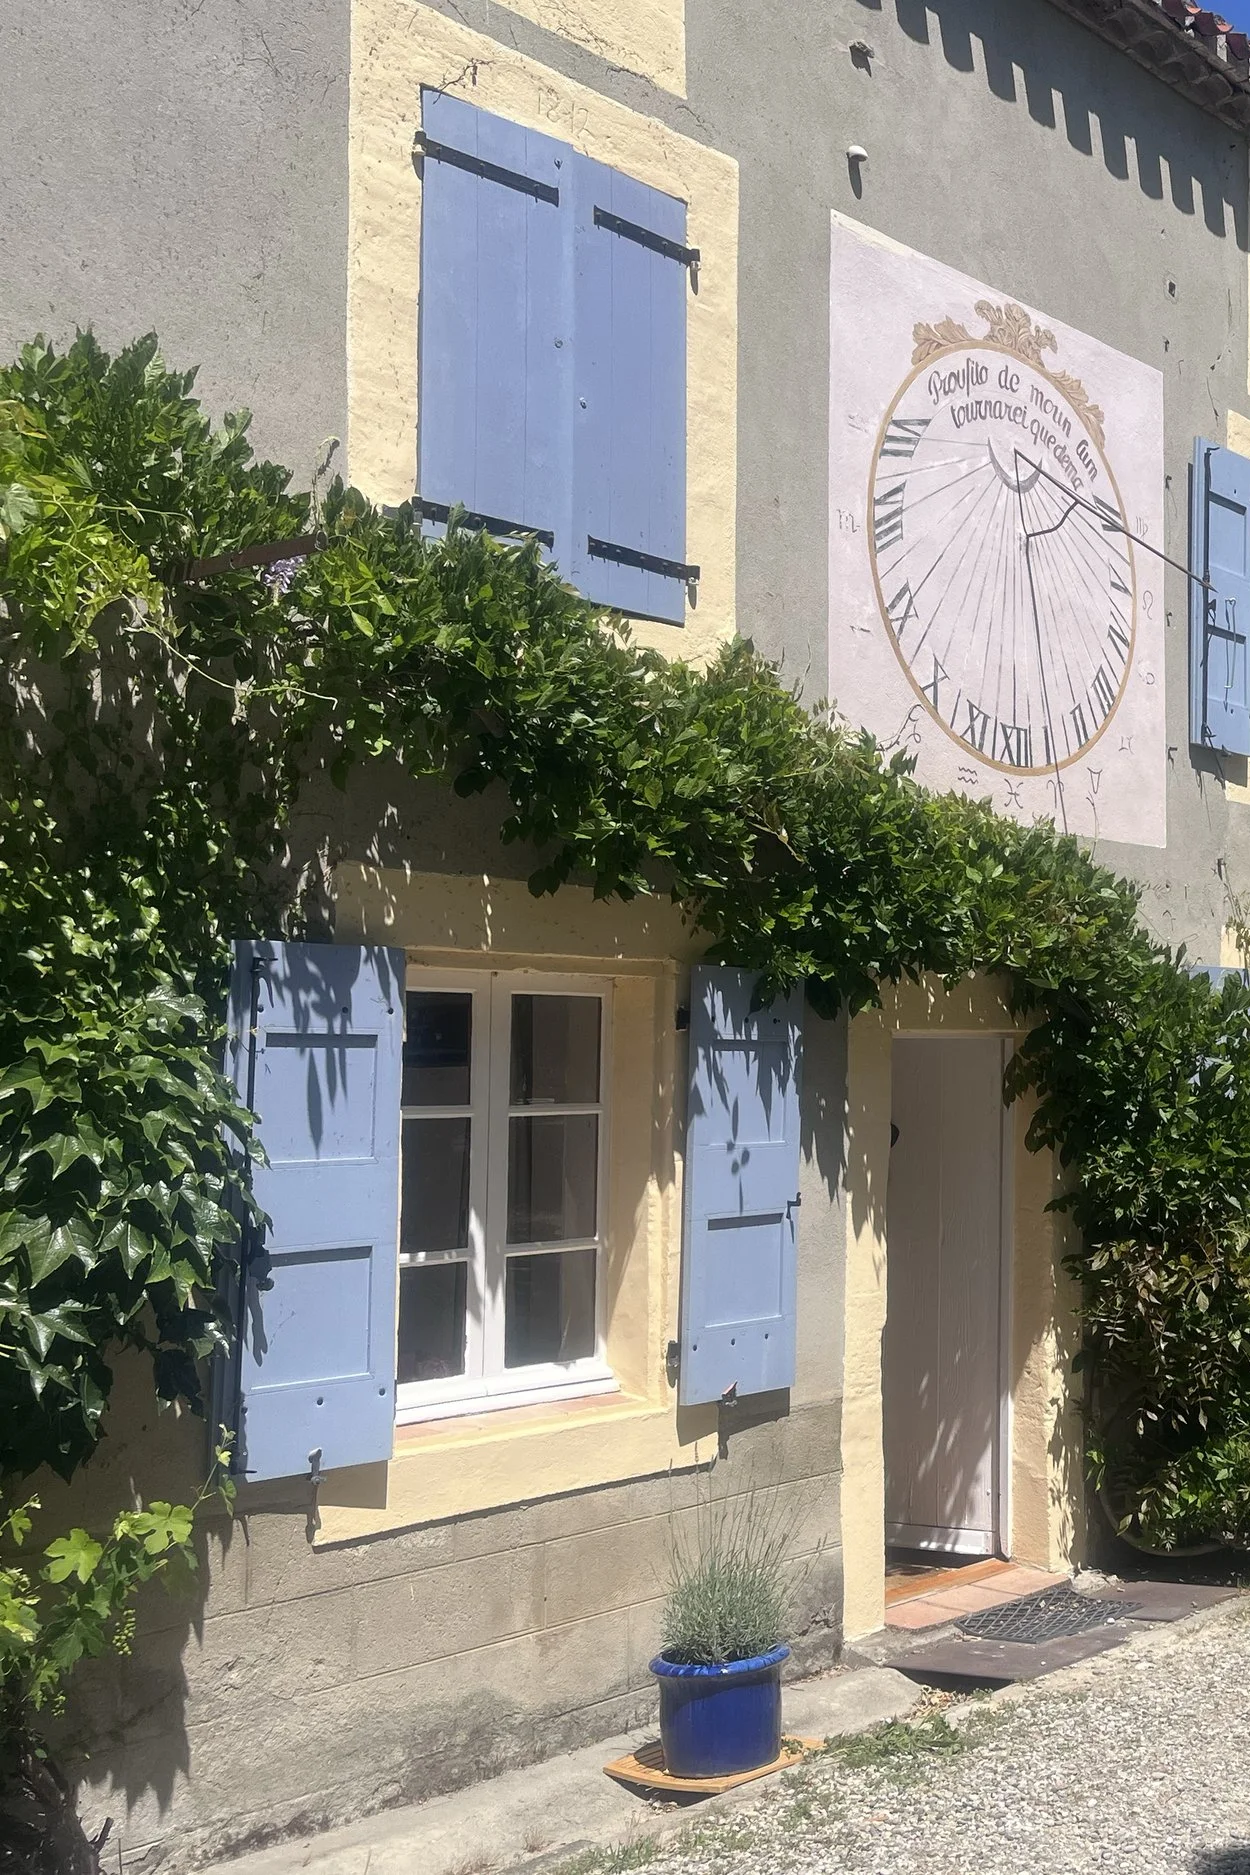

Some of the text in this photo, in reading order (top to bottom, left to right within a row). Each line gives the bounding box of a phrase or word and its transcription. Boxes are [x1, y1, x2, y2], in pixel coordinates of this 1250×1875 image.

[998, 364, 1020, 393] de
[1030, 384, 1072, 438] moun
[919, 653, 950, 714] X
[1090, 664, 1117, 721] III
[960, 699, 991, 754] XI
[1000, 722, 1029, 768] XII
[1069, 703, 1090, 751] II
